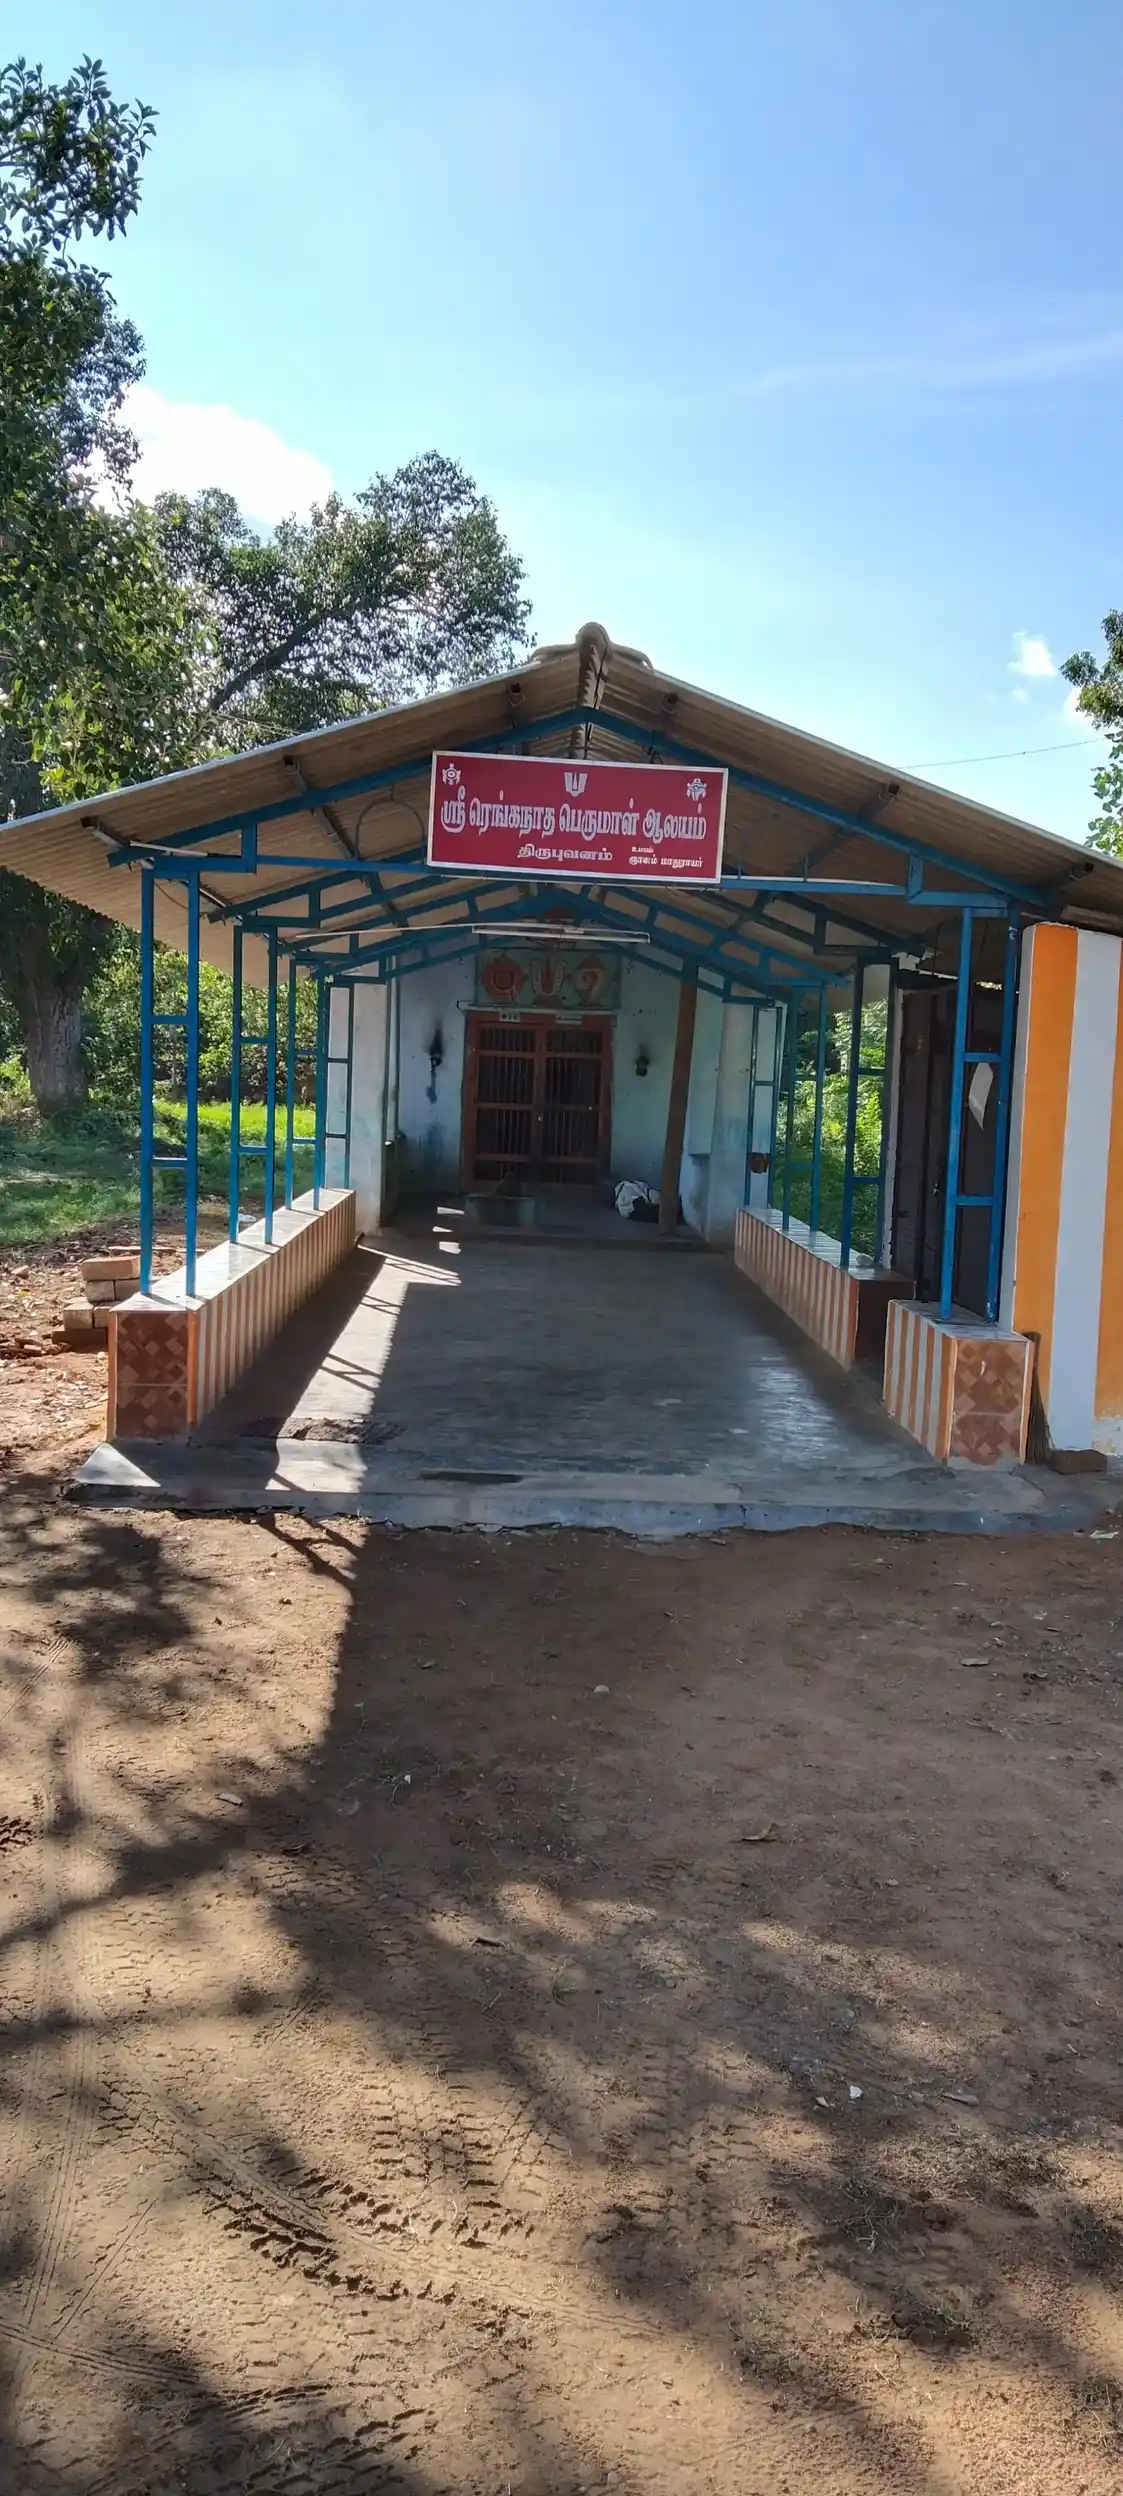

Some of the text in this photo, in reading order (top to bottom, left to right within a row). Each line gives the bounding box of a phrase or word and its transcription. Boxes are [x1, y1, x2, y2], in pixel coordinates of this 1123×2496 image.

[441, 786, 706, 844] ஸ்ரீ ரெங்கநாத பெருமாள் ஆலயம்
[517, 843, 613, 861] திருபுவனம்
